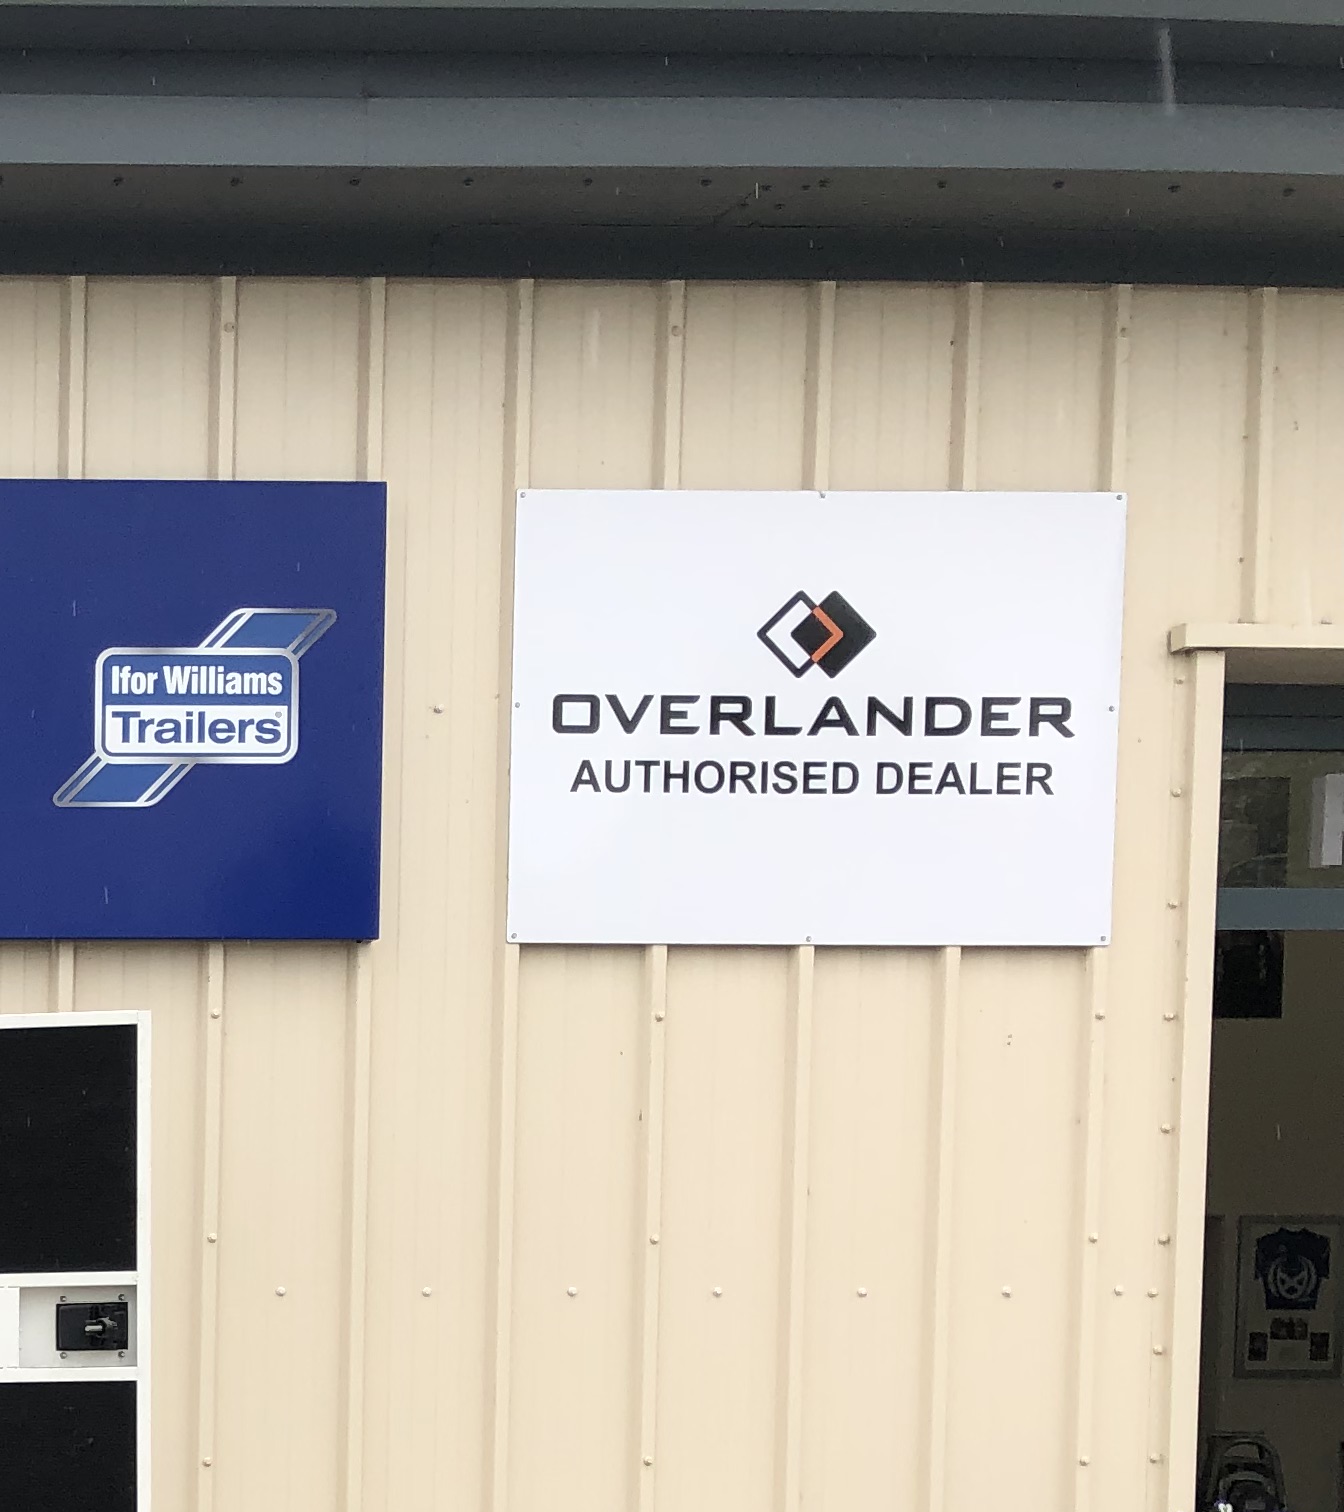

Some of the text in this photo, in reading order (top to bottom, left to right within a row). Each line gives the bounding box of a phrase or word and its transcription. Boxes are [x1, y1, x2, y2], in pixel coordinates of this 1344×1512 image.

[111, 665, 283, 695] Ifor Williams
[111, 710, 282, 745] Trailers
[552, 693, 1075, 739] OVERLANDER
[569, 759, 1054, 796] AUTHORISED DEALER
